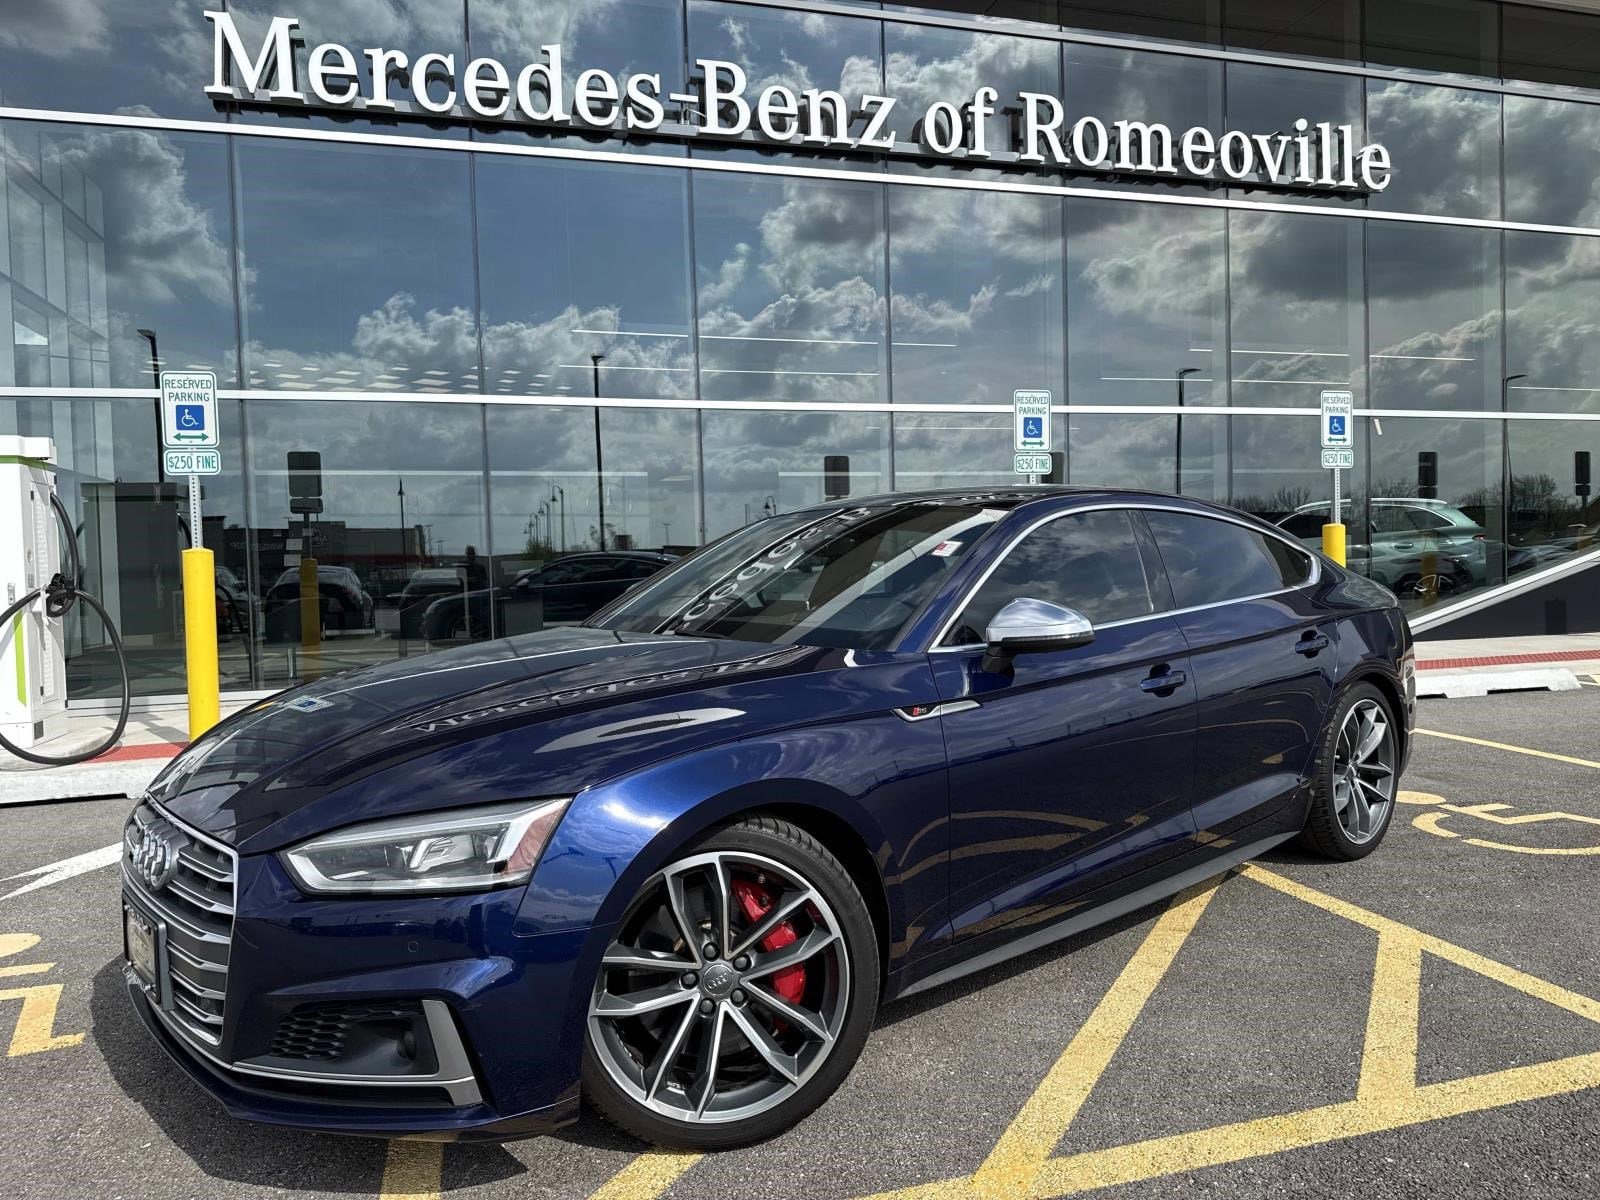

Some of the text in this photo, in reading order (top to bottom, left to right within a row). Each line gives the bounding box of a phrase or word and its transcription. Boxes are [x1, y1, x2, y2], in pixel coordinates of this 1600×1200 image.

[203, 10, 1391, 190] Mercedes-Benz of Romeoville
[164, 379, 212, 389] RESERVED
[168, 392, 210, 402] PARKING
[1016, 396, 1048, 405] RESERVED
[1323, 396, 1350, 405] RESERVED
[1018, 406, 1047, 415] PARKING
[1325, 406, 1349, 414] PARKING
[168, 455, 217, 469] $250 FINE
[1339, 453, 1351, 464] FINE
[1017, 458, 1049, 470] $250 FINE
